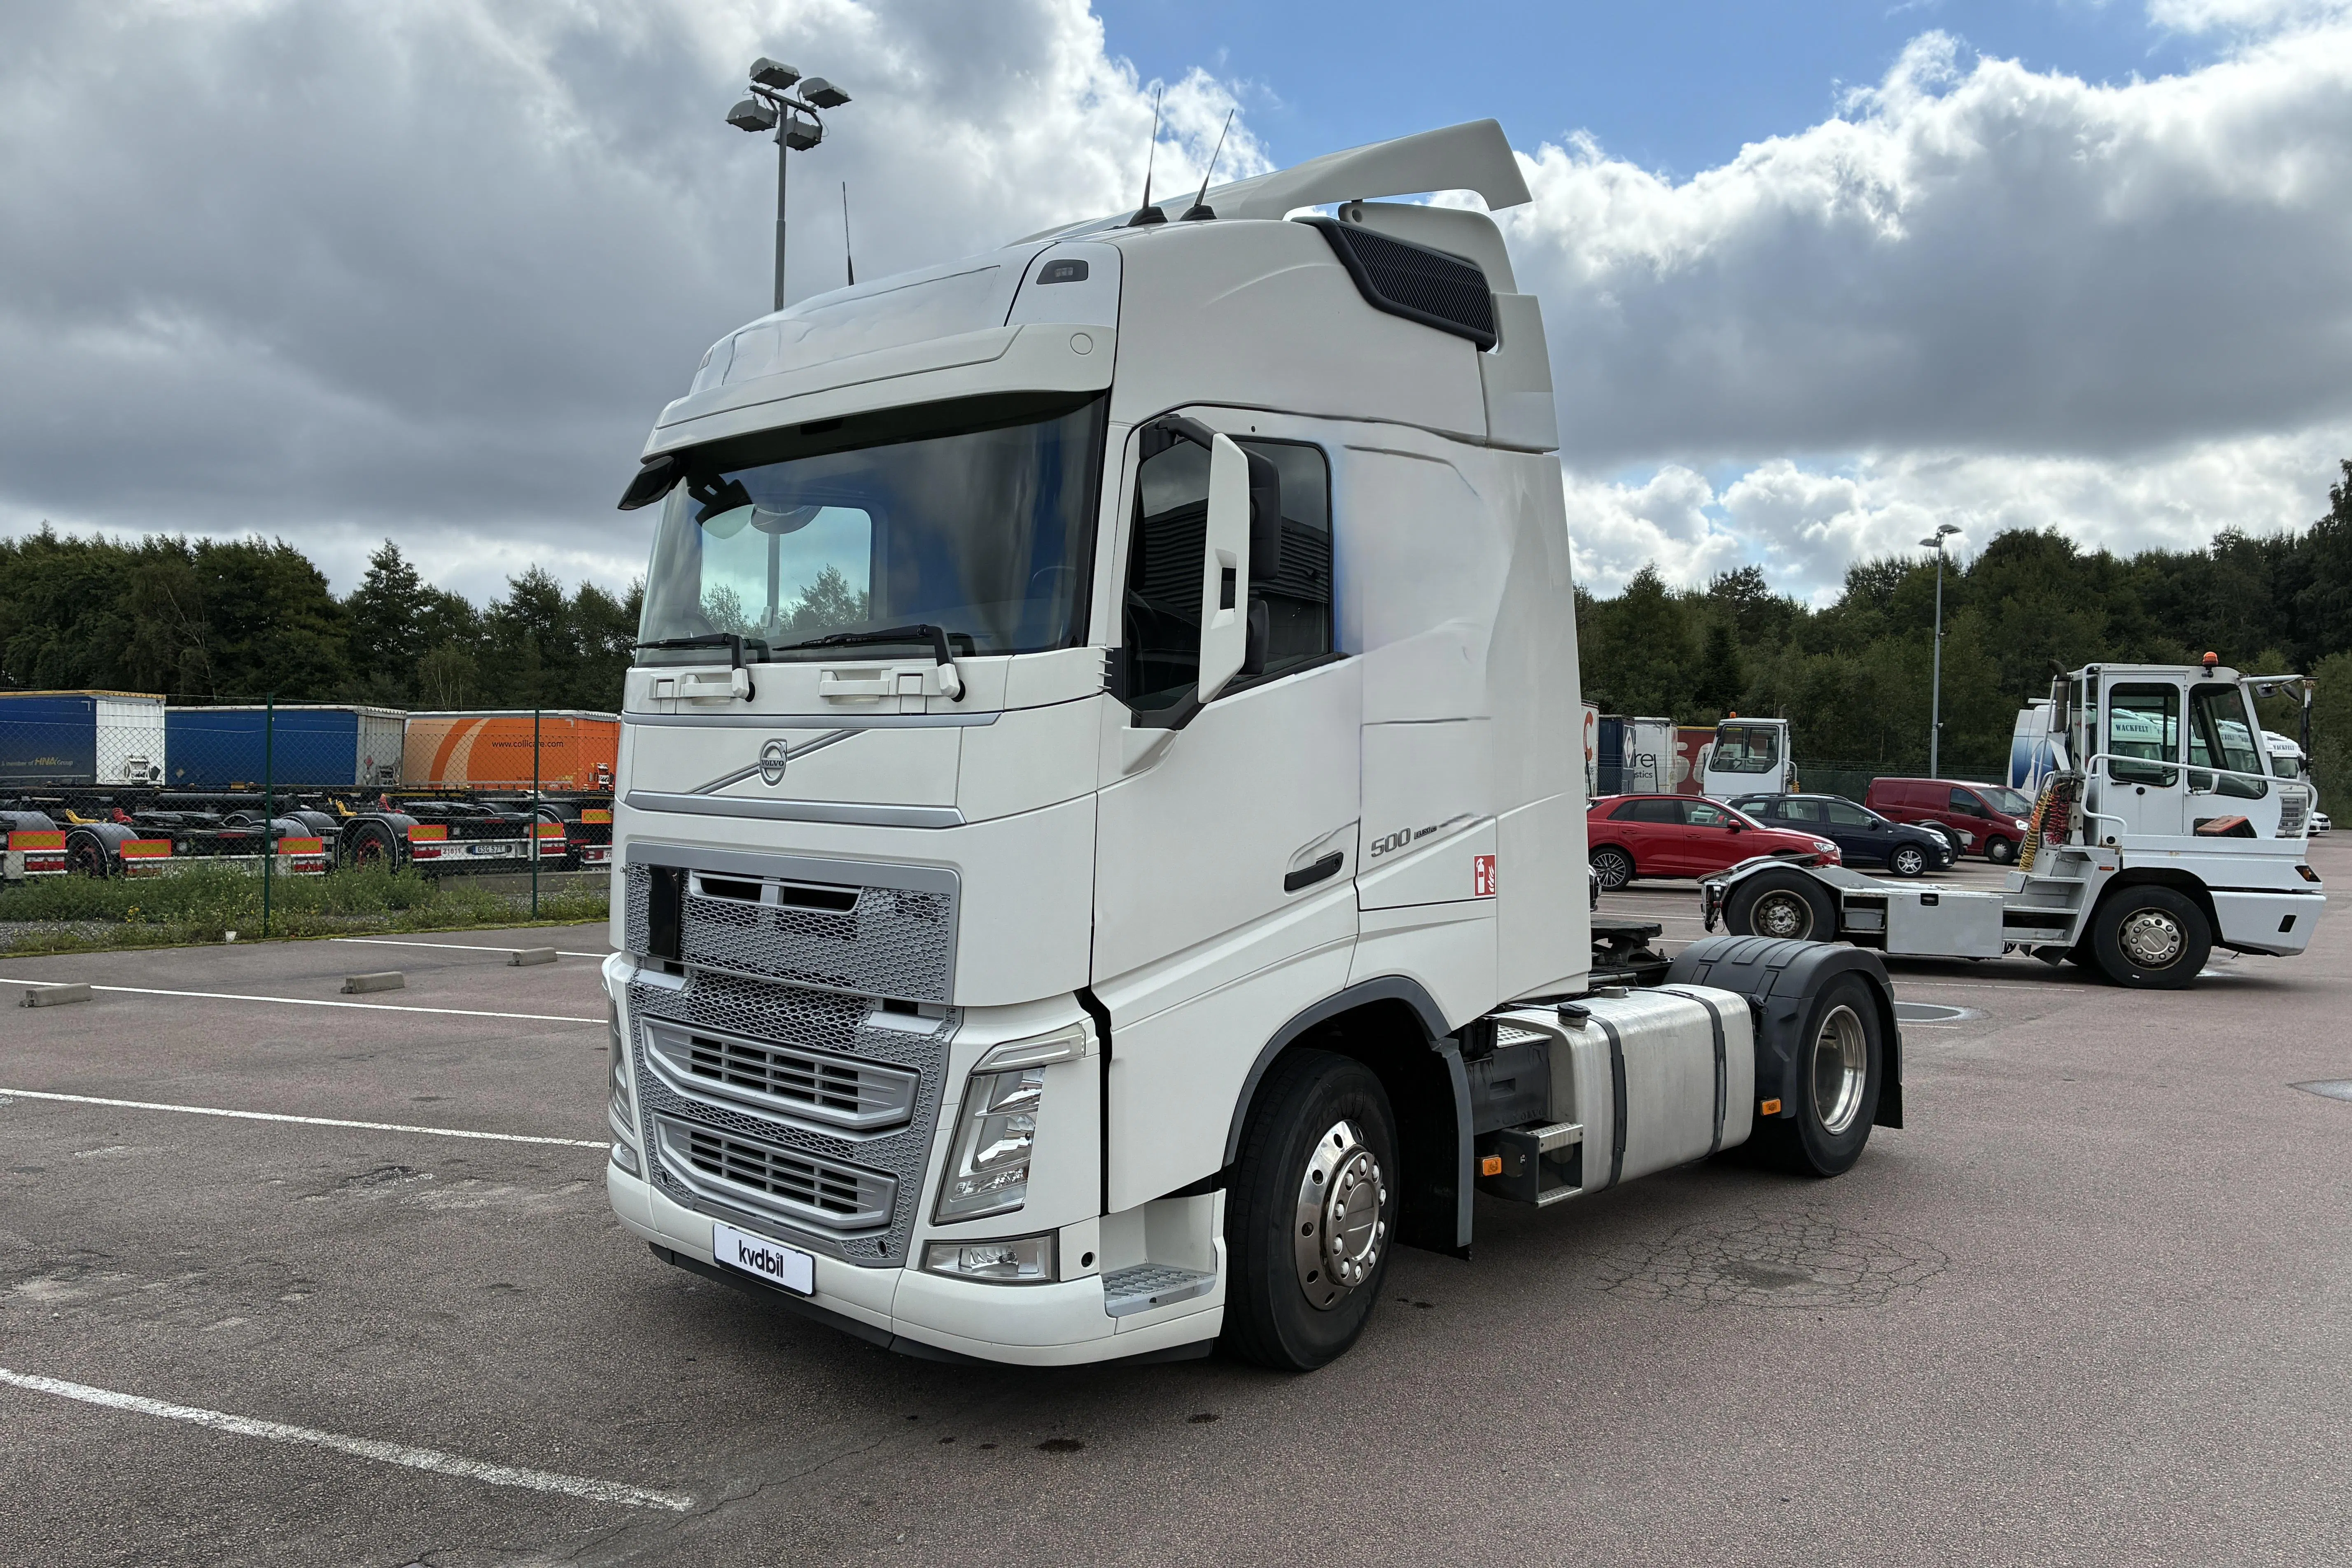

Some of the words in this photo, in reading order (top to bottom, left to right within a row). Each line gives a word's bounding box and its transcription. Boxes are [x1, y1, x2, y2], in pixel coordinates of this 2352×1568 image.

[2115, 724, 2149, 733] WACKFELT
[1634, 753, 1654, 768] re
[1371, 828, 1411, 857] 500
[739, 1239, 783, 1278] kvdbil
